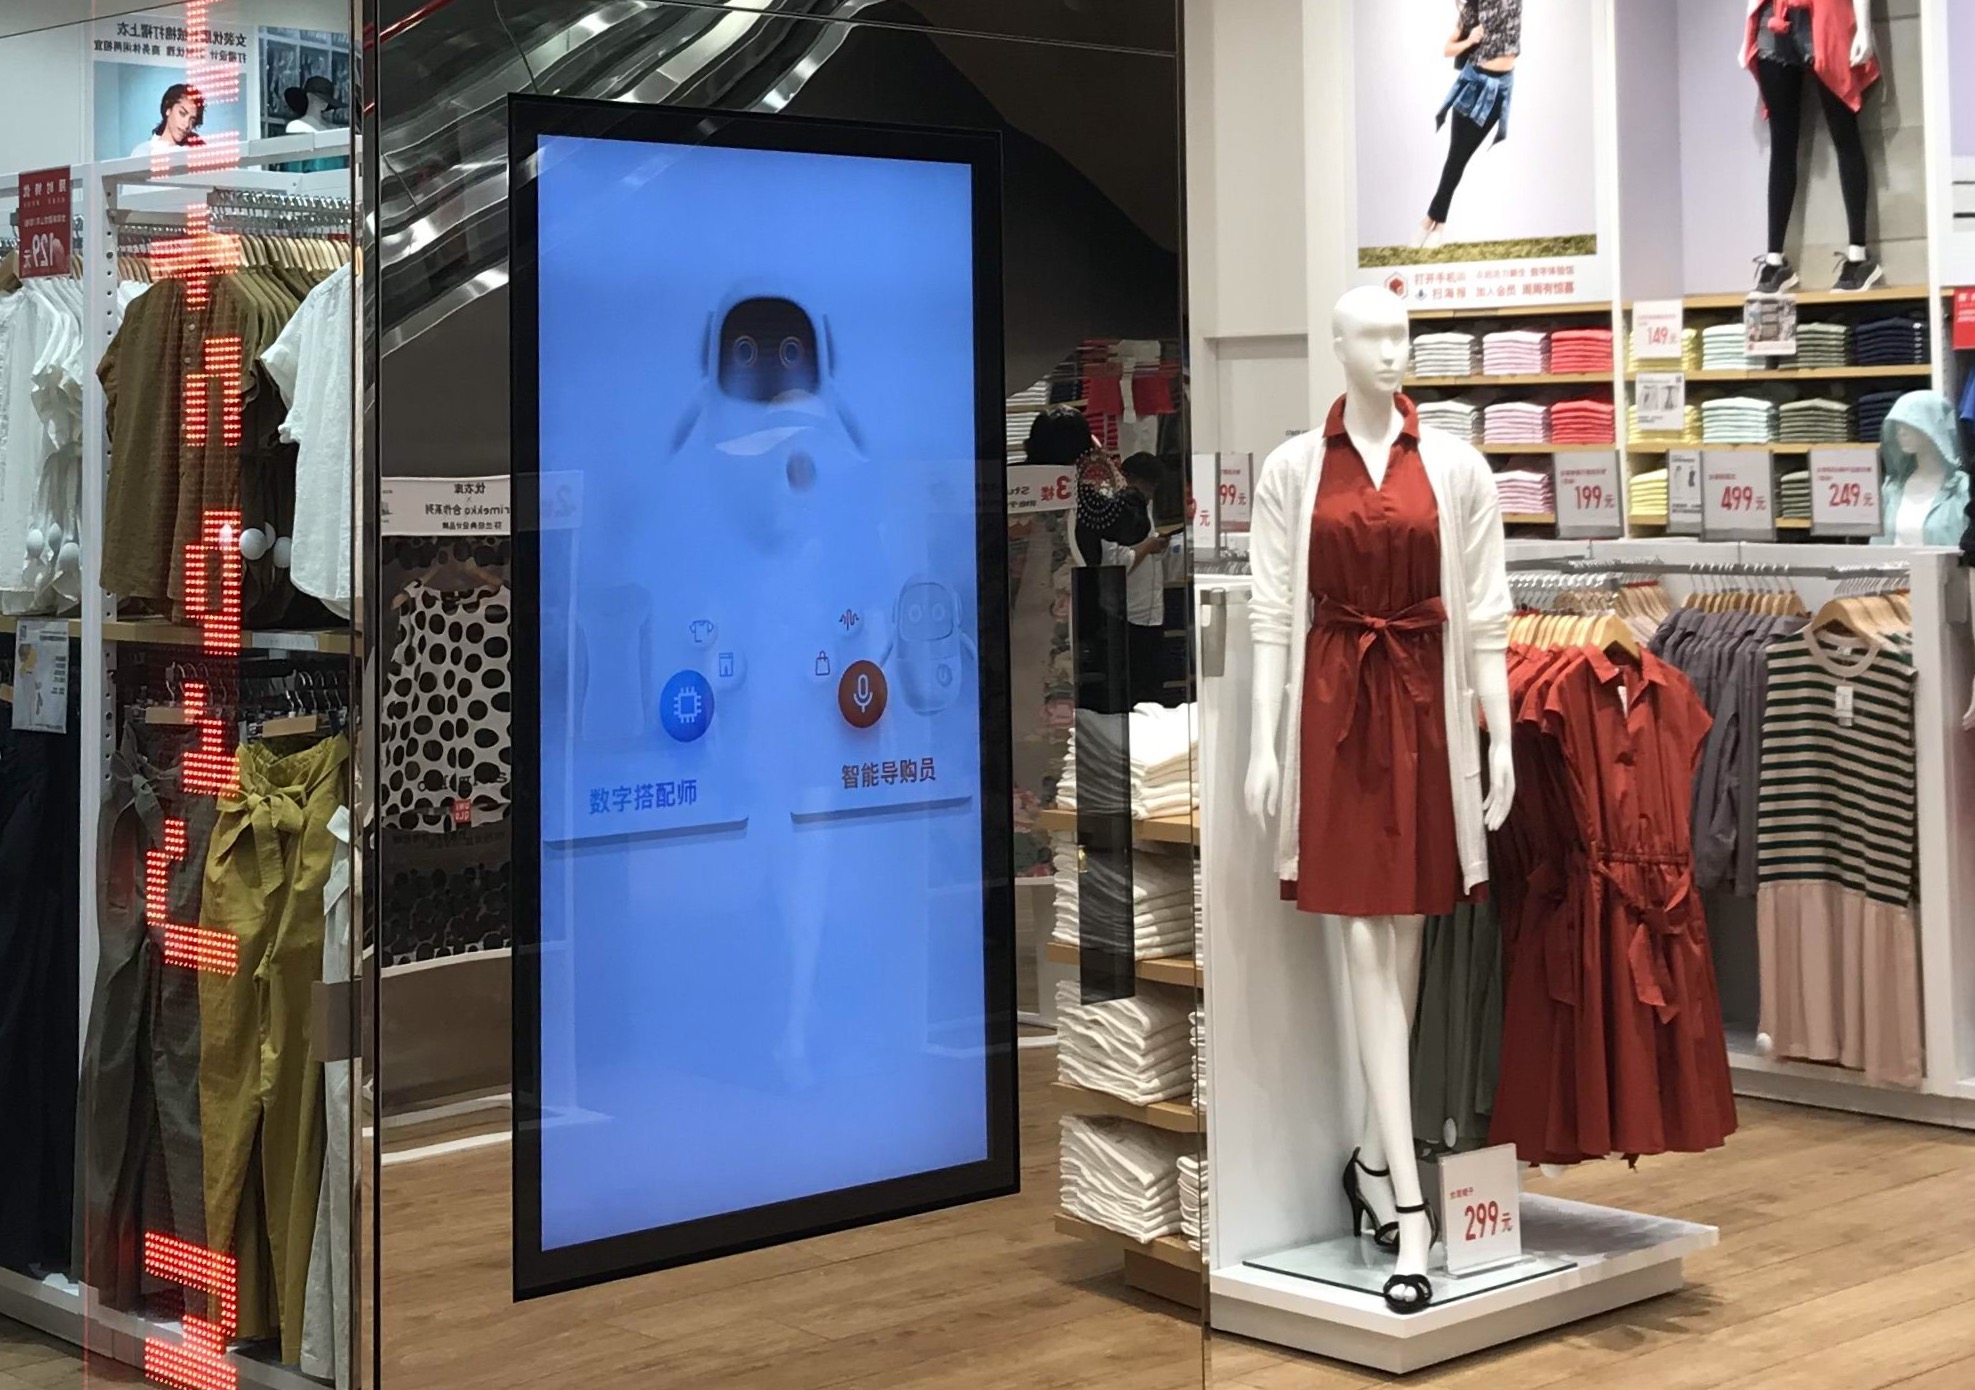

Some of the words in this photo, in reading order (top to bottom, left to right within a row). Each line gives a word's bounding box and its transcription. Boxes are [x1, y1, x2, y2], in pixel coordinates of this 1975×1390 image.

[841, 757, 937, 791] 智能导购员
[588, 778, 698, 815] 数字搭配师
